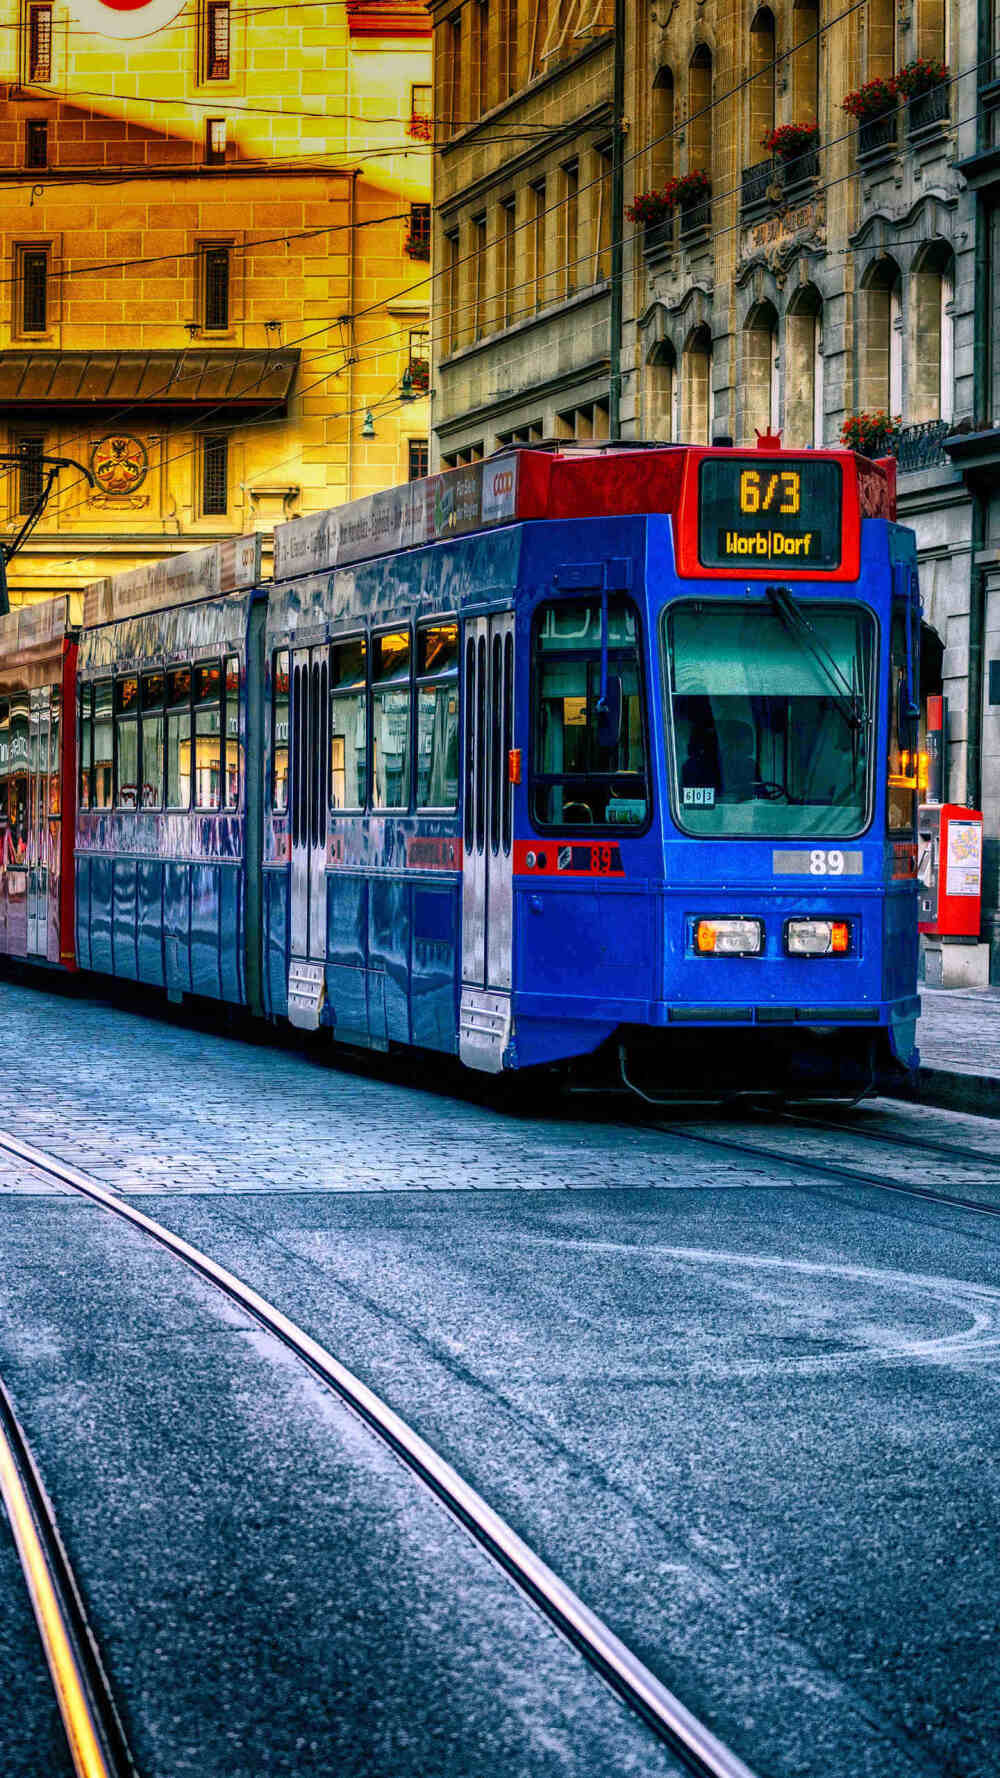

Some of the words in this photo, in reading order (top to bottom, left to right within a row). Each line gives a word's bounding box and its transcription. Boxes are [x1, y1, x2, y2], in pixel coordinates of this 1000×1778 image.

[741, 470, 799, 513] 6/3
[591, 846, 611, 874] 89
[809, 850, 844, 875] 89
